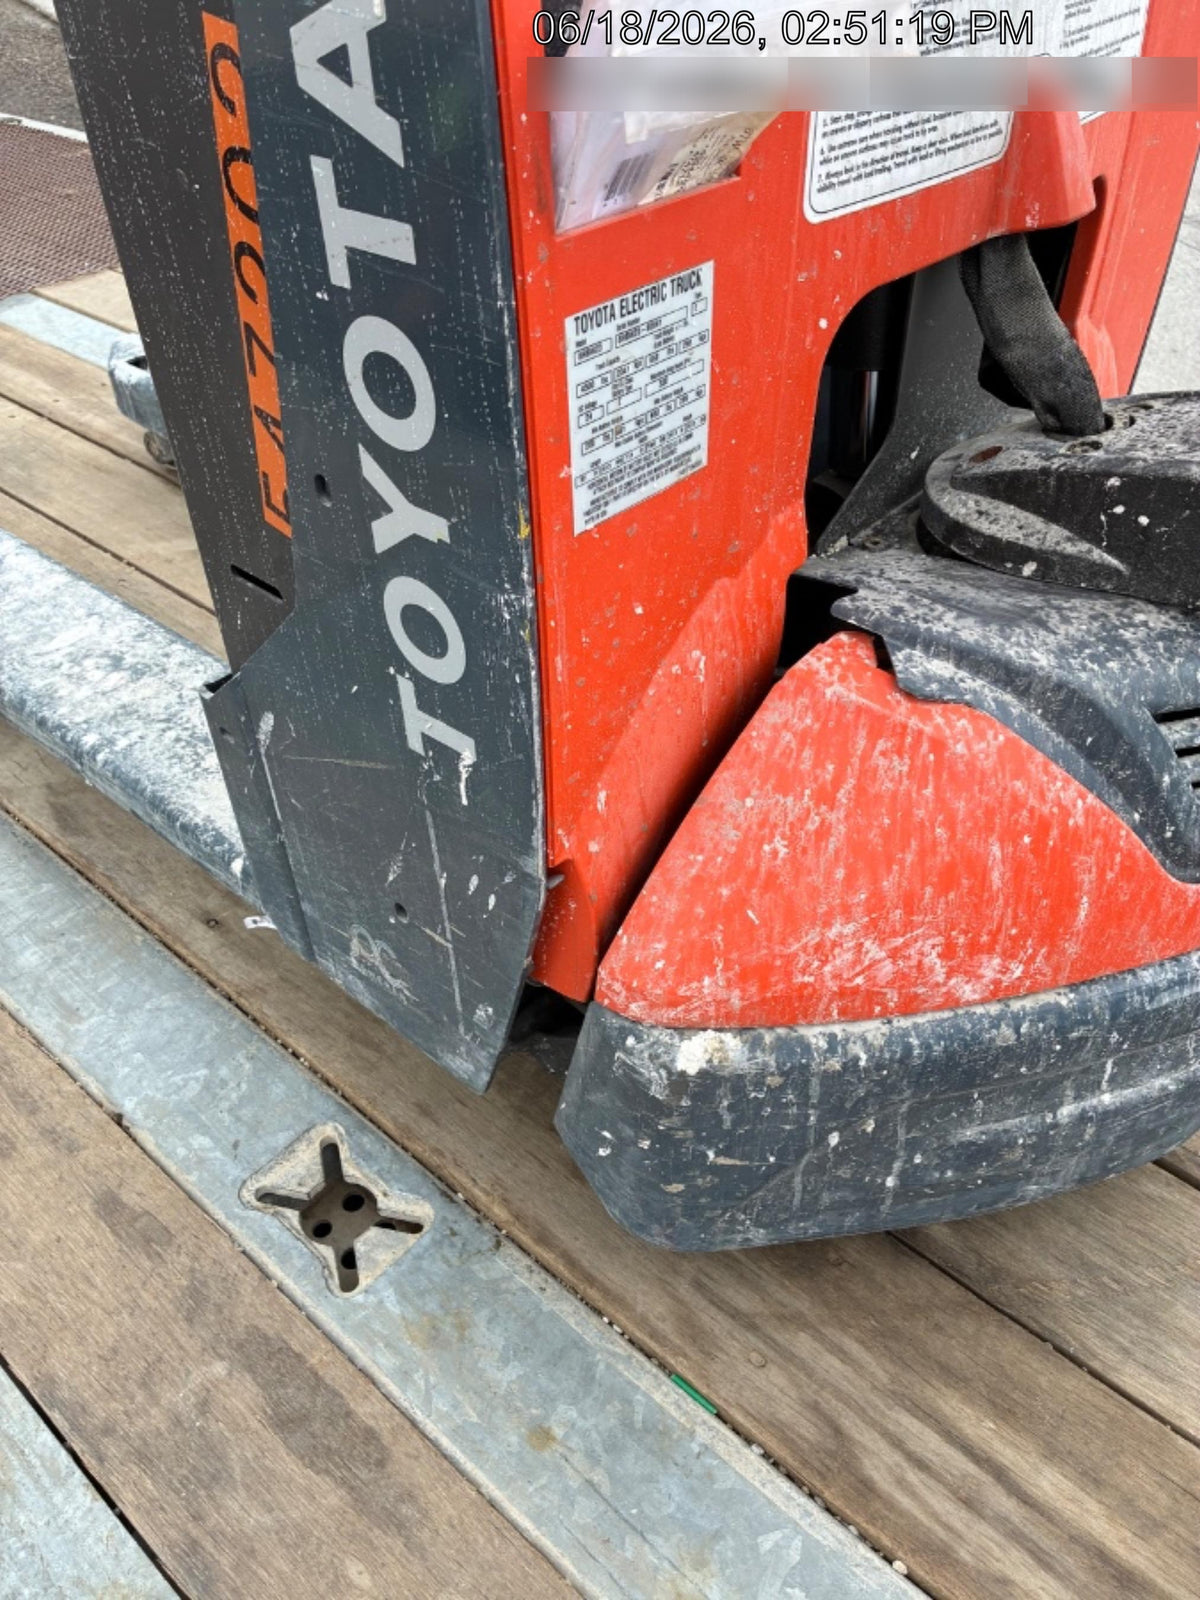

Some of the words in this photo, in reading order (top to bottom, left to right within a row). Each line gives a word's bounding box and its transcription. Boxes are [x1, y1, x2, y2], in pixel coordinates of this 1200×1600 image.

[290, 0, 477, 764] TOYOTA
[574, 303, 616, 336] TOYOTA
[620, 283, 667, 318] ELECTRIC
[670, 268, 703, 298] TRUCK
